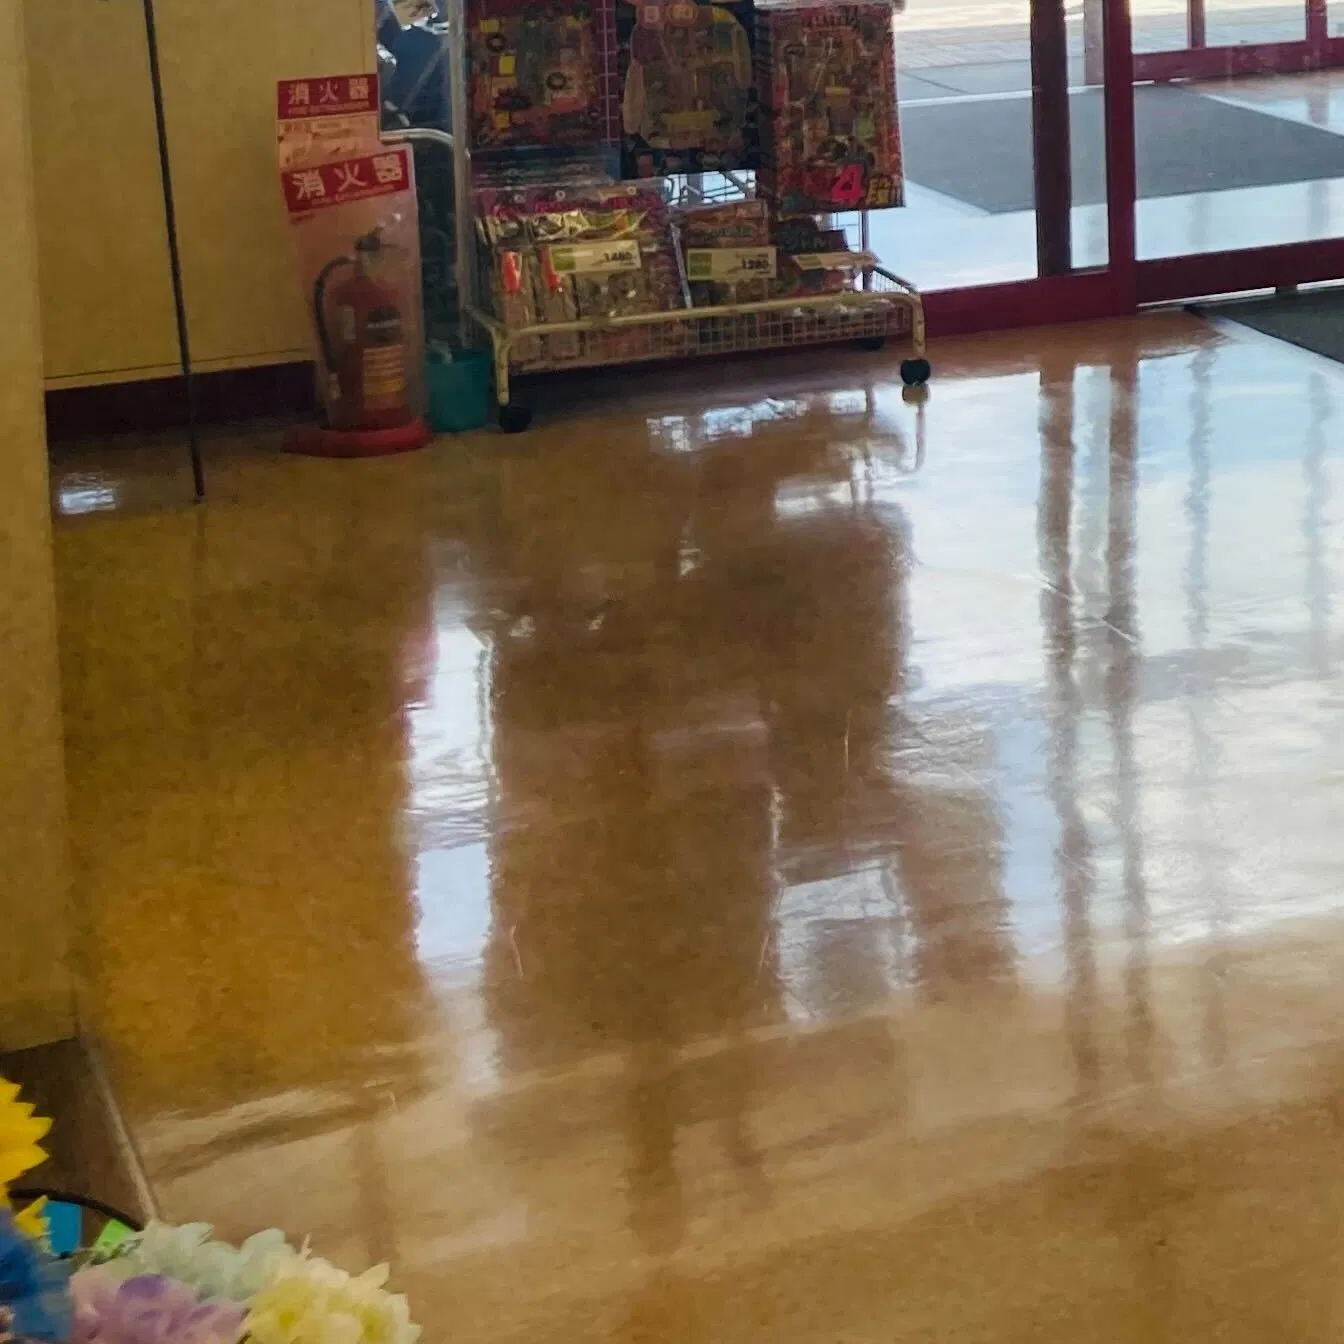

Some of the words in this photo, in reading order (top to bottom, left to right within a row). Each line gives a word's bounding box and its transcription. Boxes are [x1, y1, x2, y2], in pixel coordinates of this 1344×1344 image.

[287, 77, 370, 106] 消火器
[291, 153, 404, 201] 消火器
